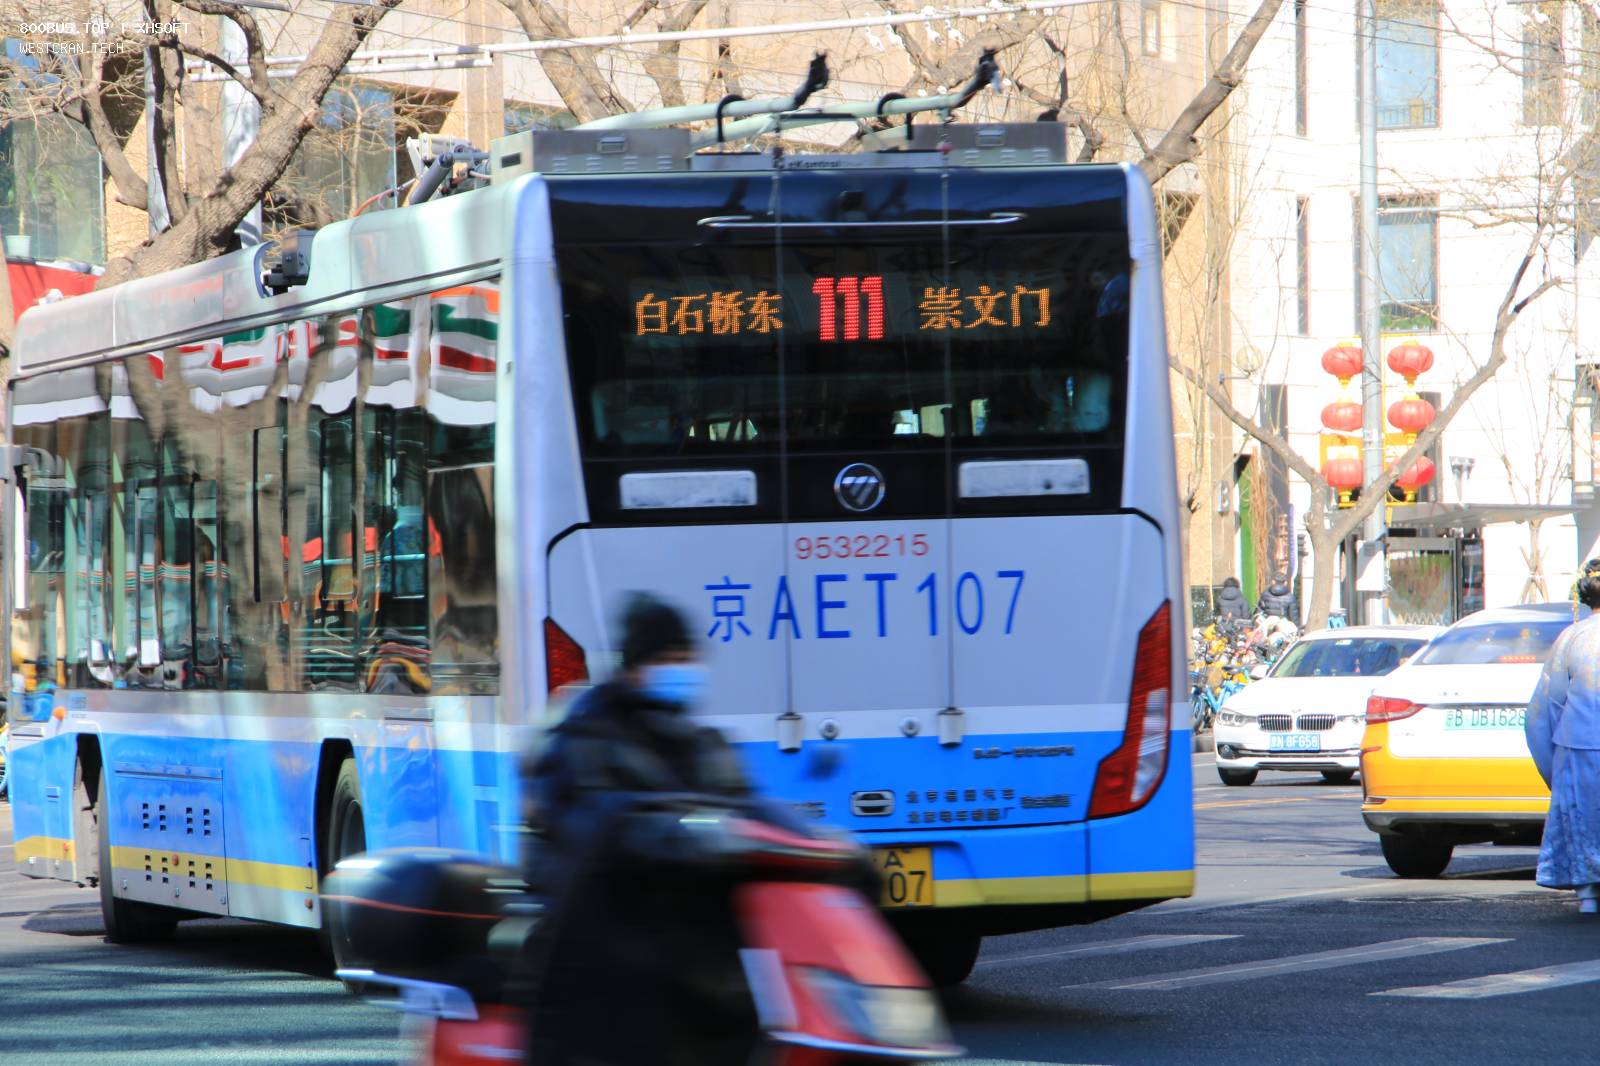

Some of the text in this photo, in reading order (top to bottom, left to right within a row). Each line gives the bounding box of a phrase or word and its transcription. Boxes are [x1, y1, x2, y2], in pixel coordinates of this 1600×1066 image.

[635, 276, 1050, 340] 白石桥东 111 崇文门
[795, 534, 929, 559] 9532215
[704, 570, 1025, 642] 京AET107
